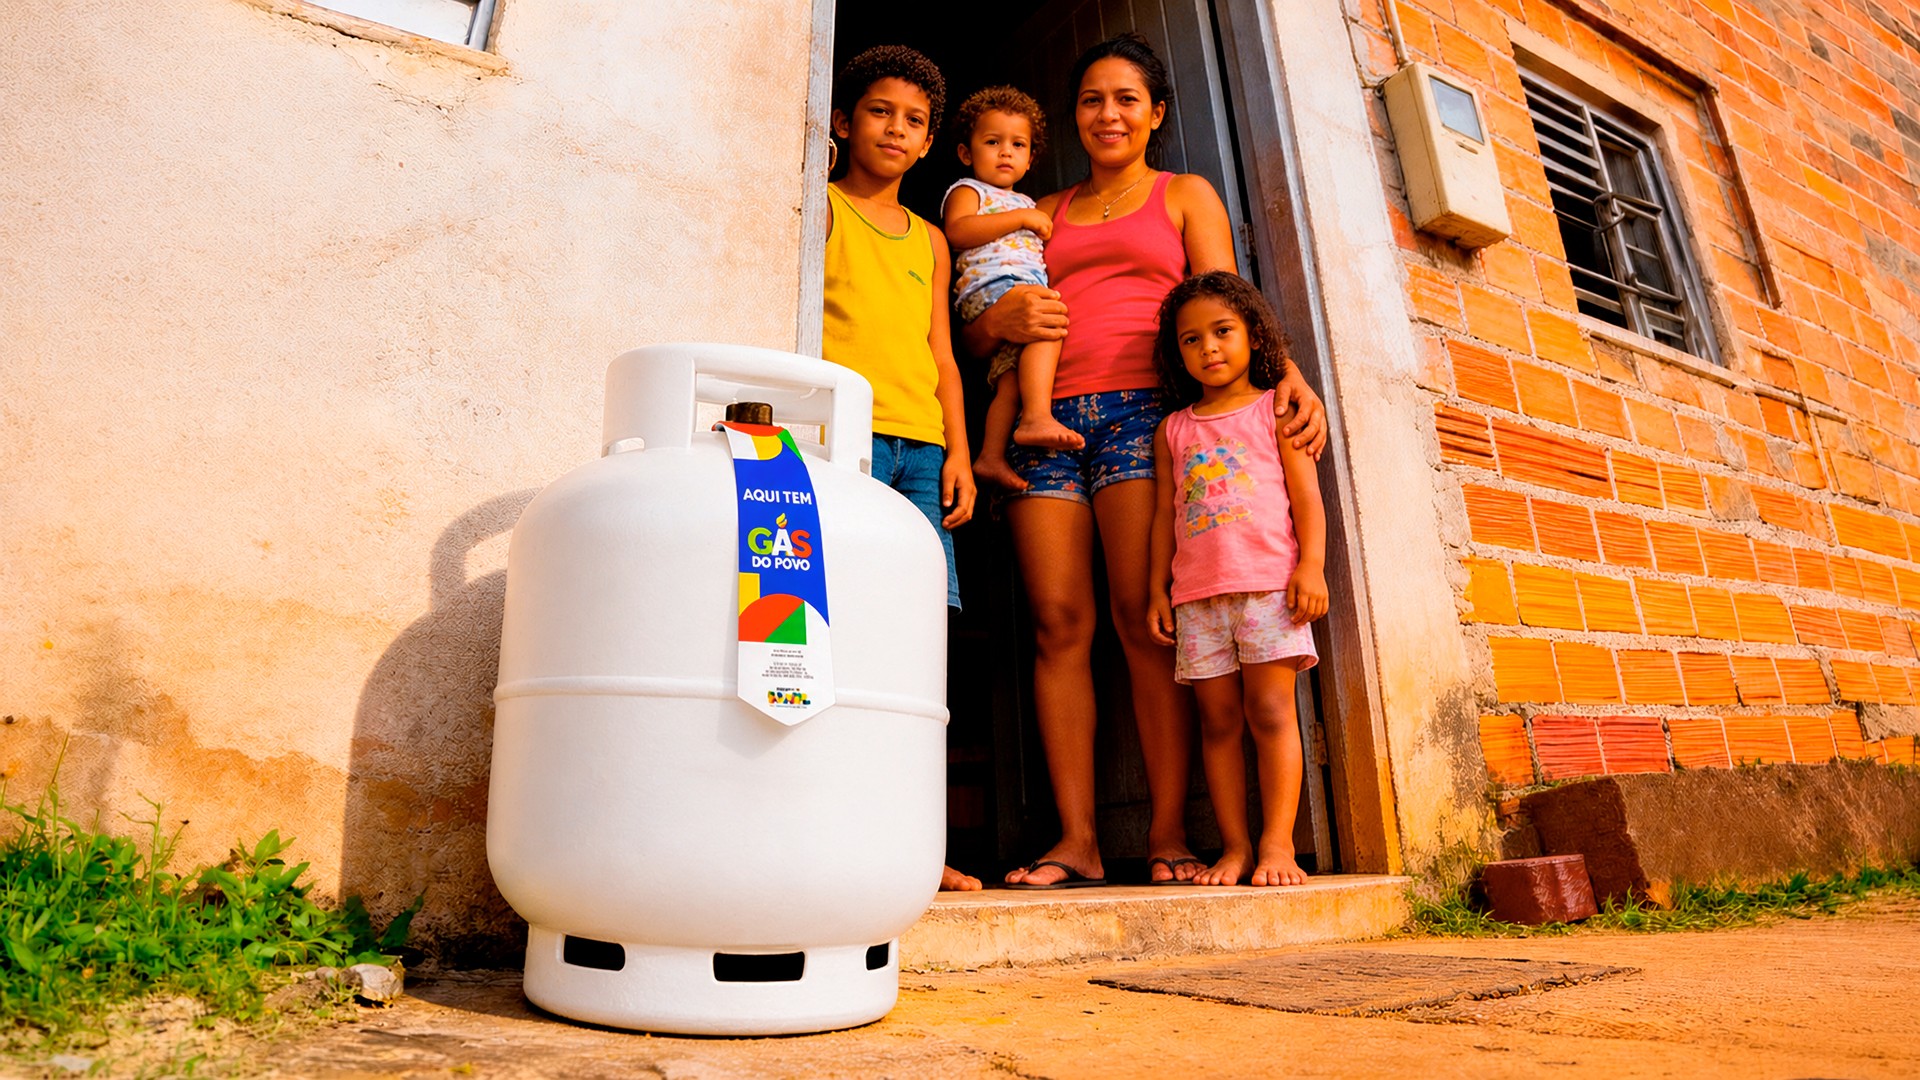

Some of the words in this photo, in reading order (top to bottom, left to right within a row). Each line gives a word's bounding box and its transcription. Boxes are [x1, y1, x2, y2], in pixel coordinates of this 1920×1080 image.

[743, 488, 780, 503] AQUI
[782, 491, 812, 505] TEM
[751, 556, 772, 568] DO
[774, 557, 810, 571] POVO
